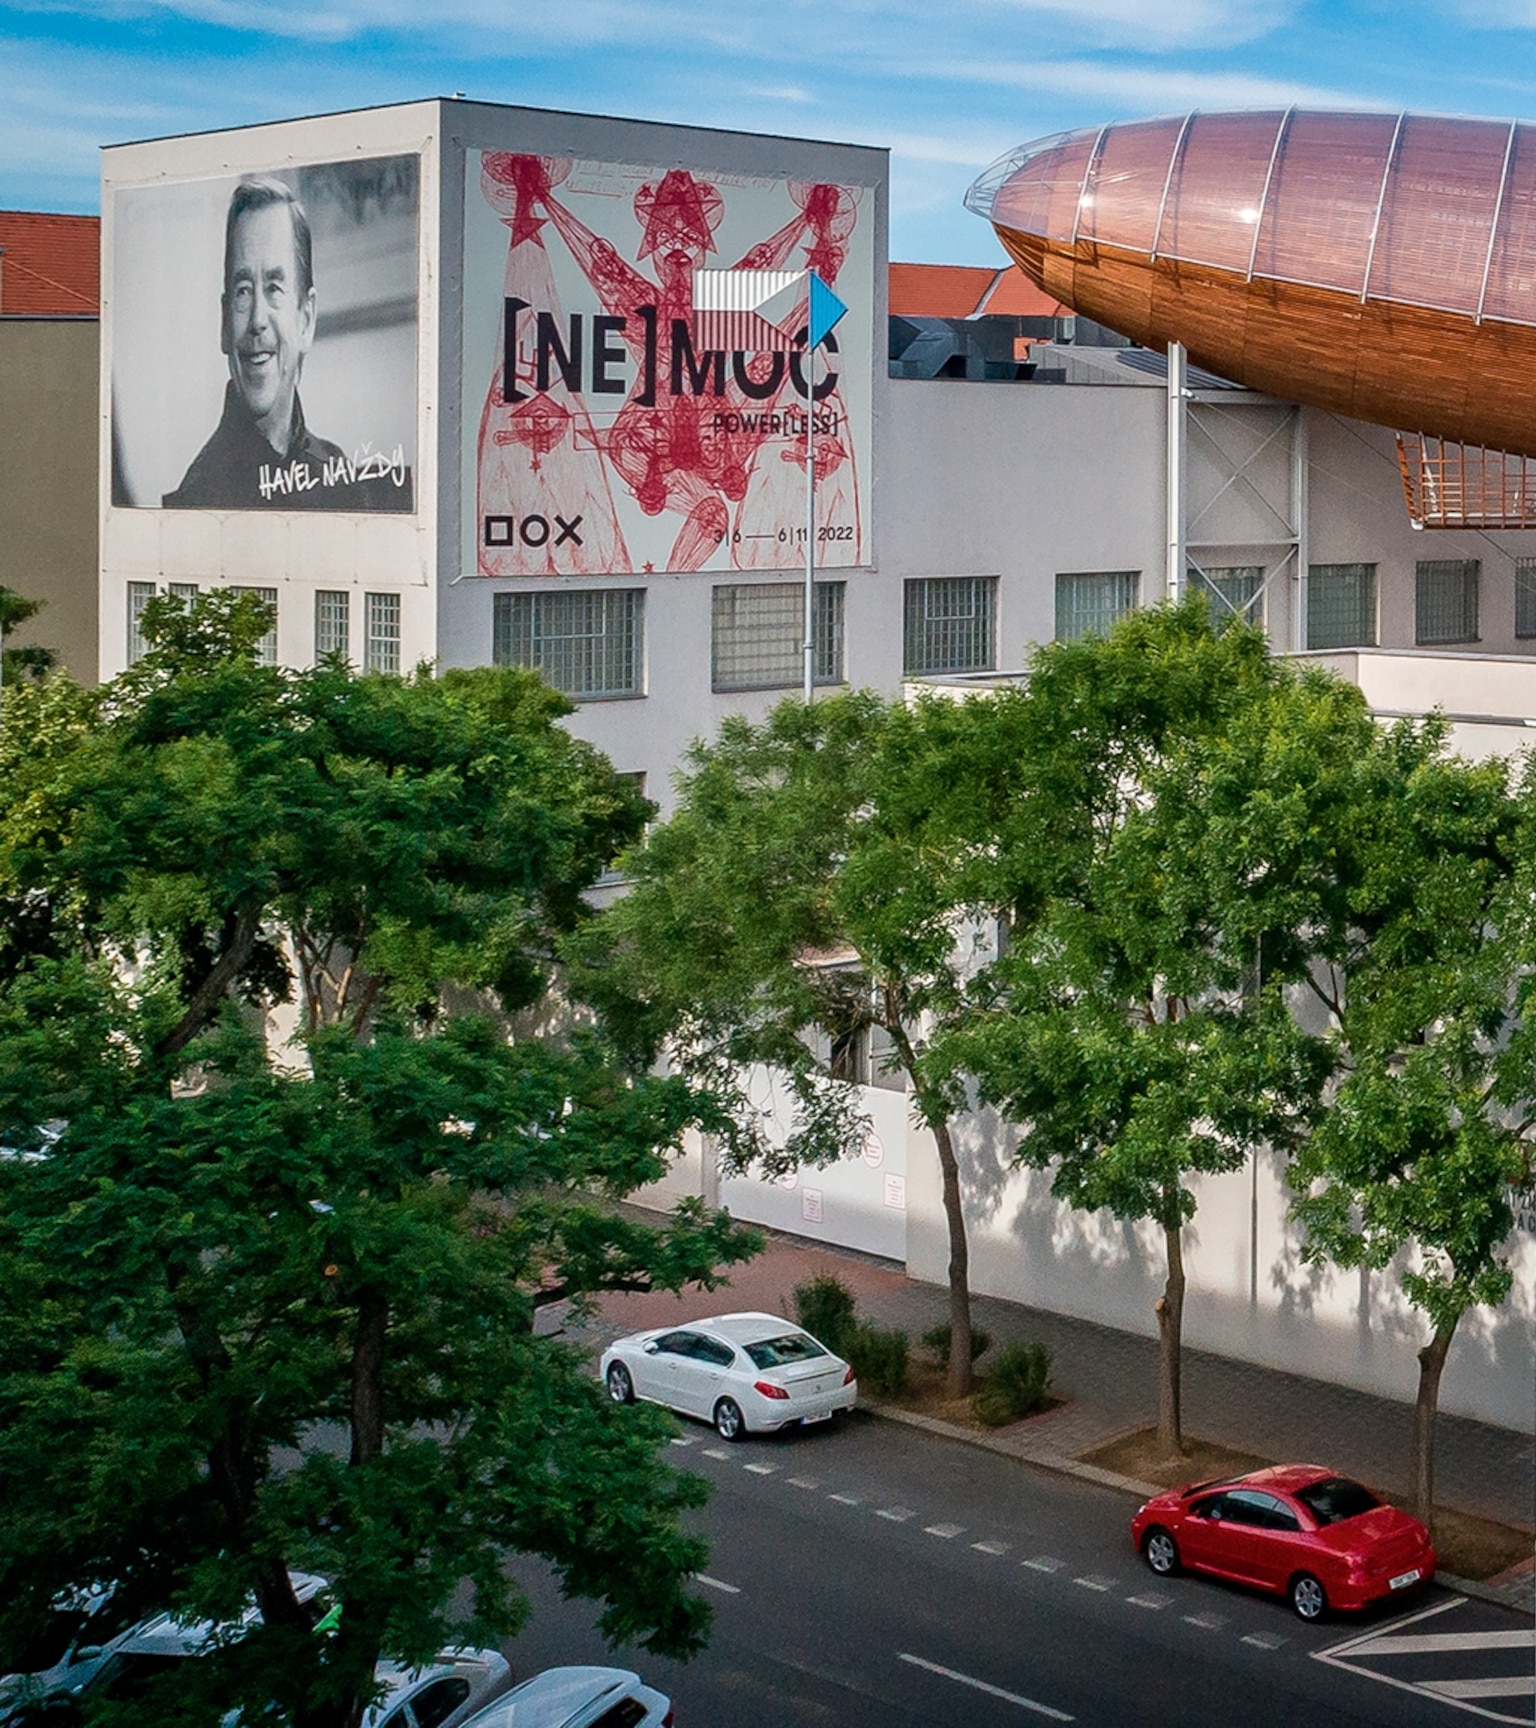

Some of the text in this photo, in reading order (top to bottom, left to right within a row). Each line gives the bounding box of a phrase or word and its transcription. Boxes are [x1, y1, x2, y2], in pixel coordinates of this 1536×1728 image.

[259, 441, 405, 500] HAVEL NAVŽDY
[817, 527, 853, 542] 2022
